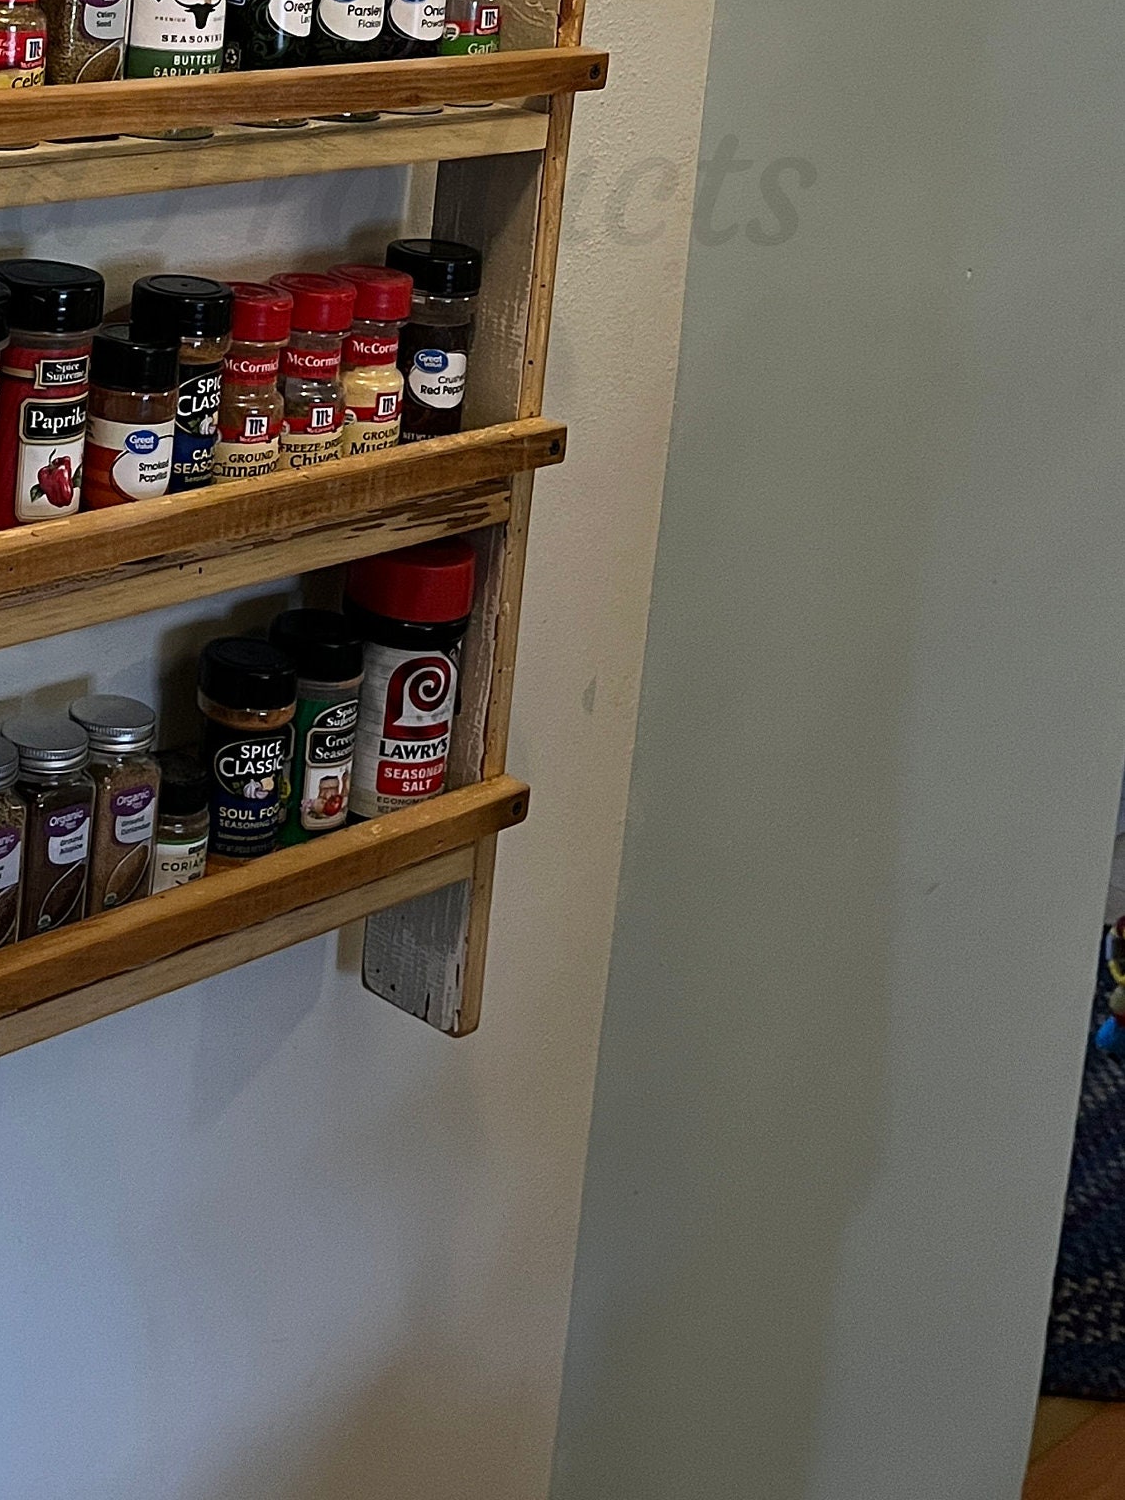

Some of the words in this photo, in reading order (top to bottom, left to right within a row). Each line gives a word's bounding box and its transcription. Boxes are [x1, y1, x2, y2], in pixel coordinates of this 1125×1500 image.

[347, 4, 382, 18] Parsley
[55, 362, 80, 372] Spice
[420, 385, 441, 395] Red
[129, 435, 154, 444] Great
[228, 450, 274, 464] GROUND
[241, 740, 282, 759] SPICE
[378, 736, 449, 761] LAWRY'S
[384, 763, 444, 780] SEASONED
[402, 779, 432, 792] SALT
[116, 788, 150, 806] Organic
[49, 809, 84, 827] Organic
[219, 807, 256, 821] SOUL
